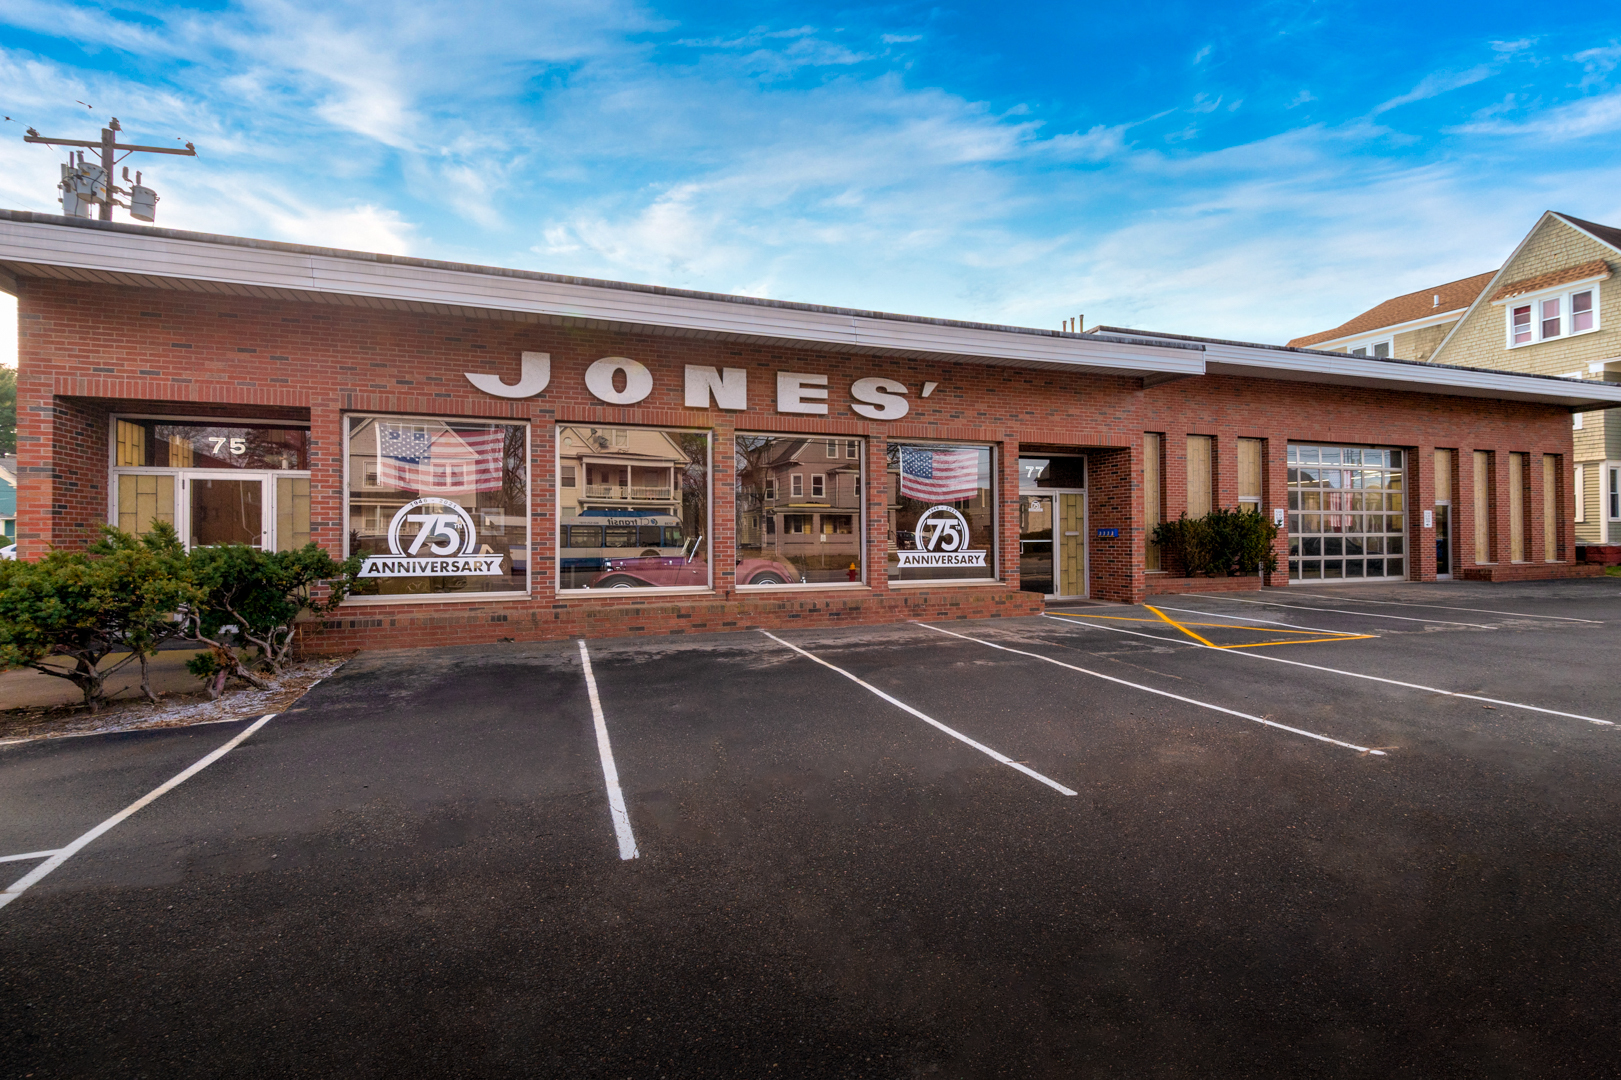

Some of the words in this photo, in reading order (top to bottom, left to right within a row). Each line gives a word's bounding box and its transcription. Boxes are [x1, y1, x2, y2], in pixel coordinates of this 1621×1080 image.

[208, 436, 246, 455] 75
[1025, 465, 1045, 478] 77
[903, 555, 981, 565] ANNIVERSARY
[367, 560, 495, 574] ANNIVERSARY
